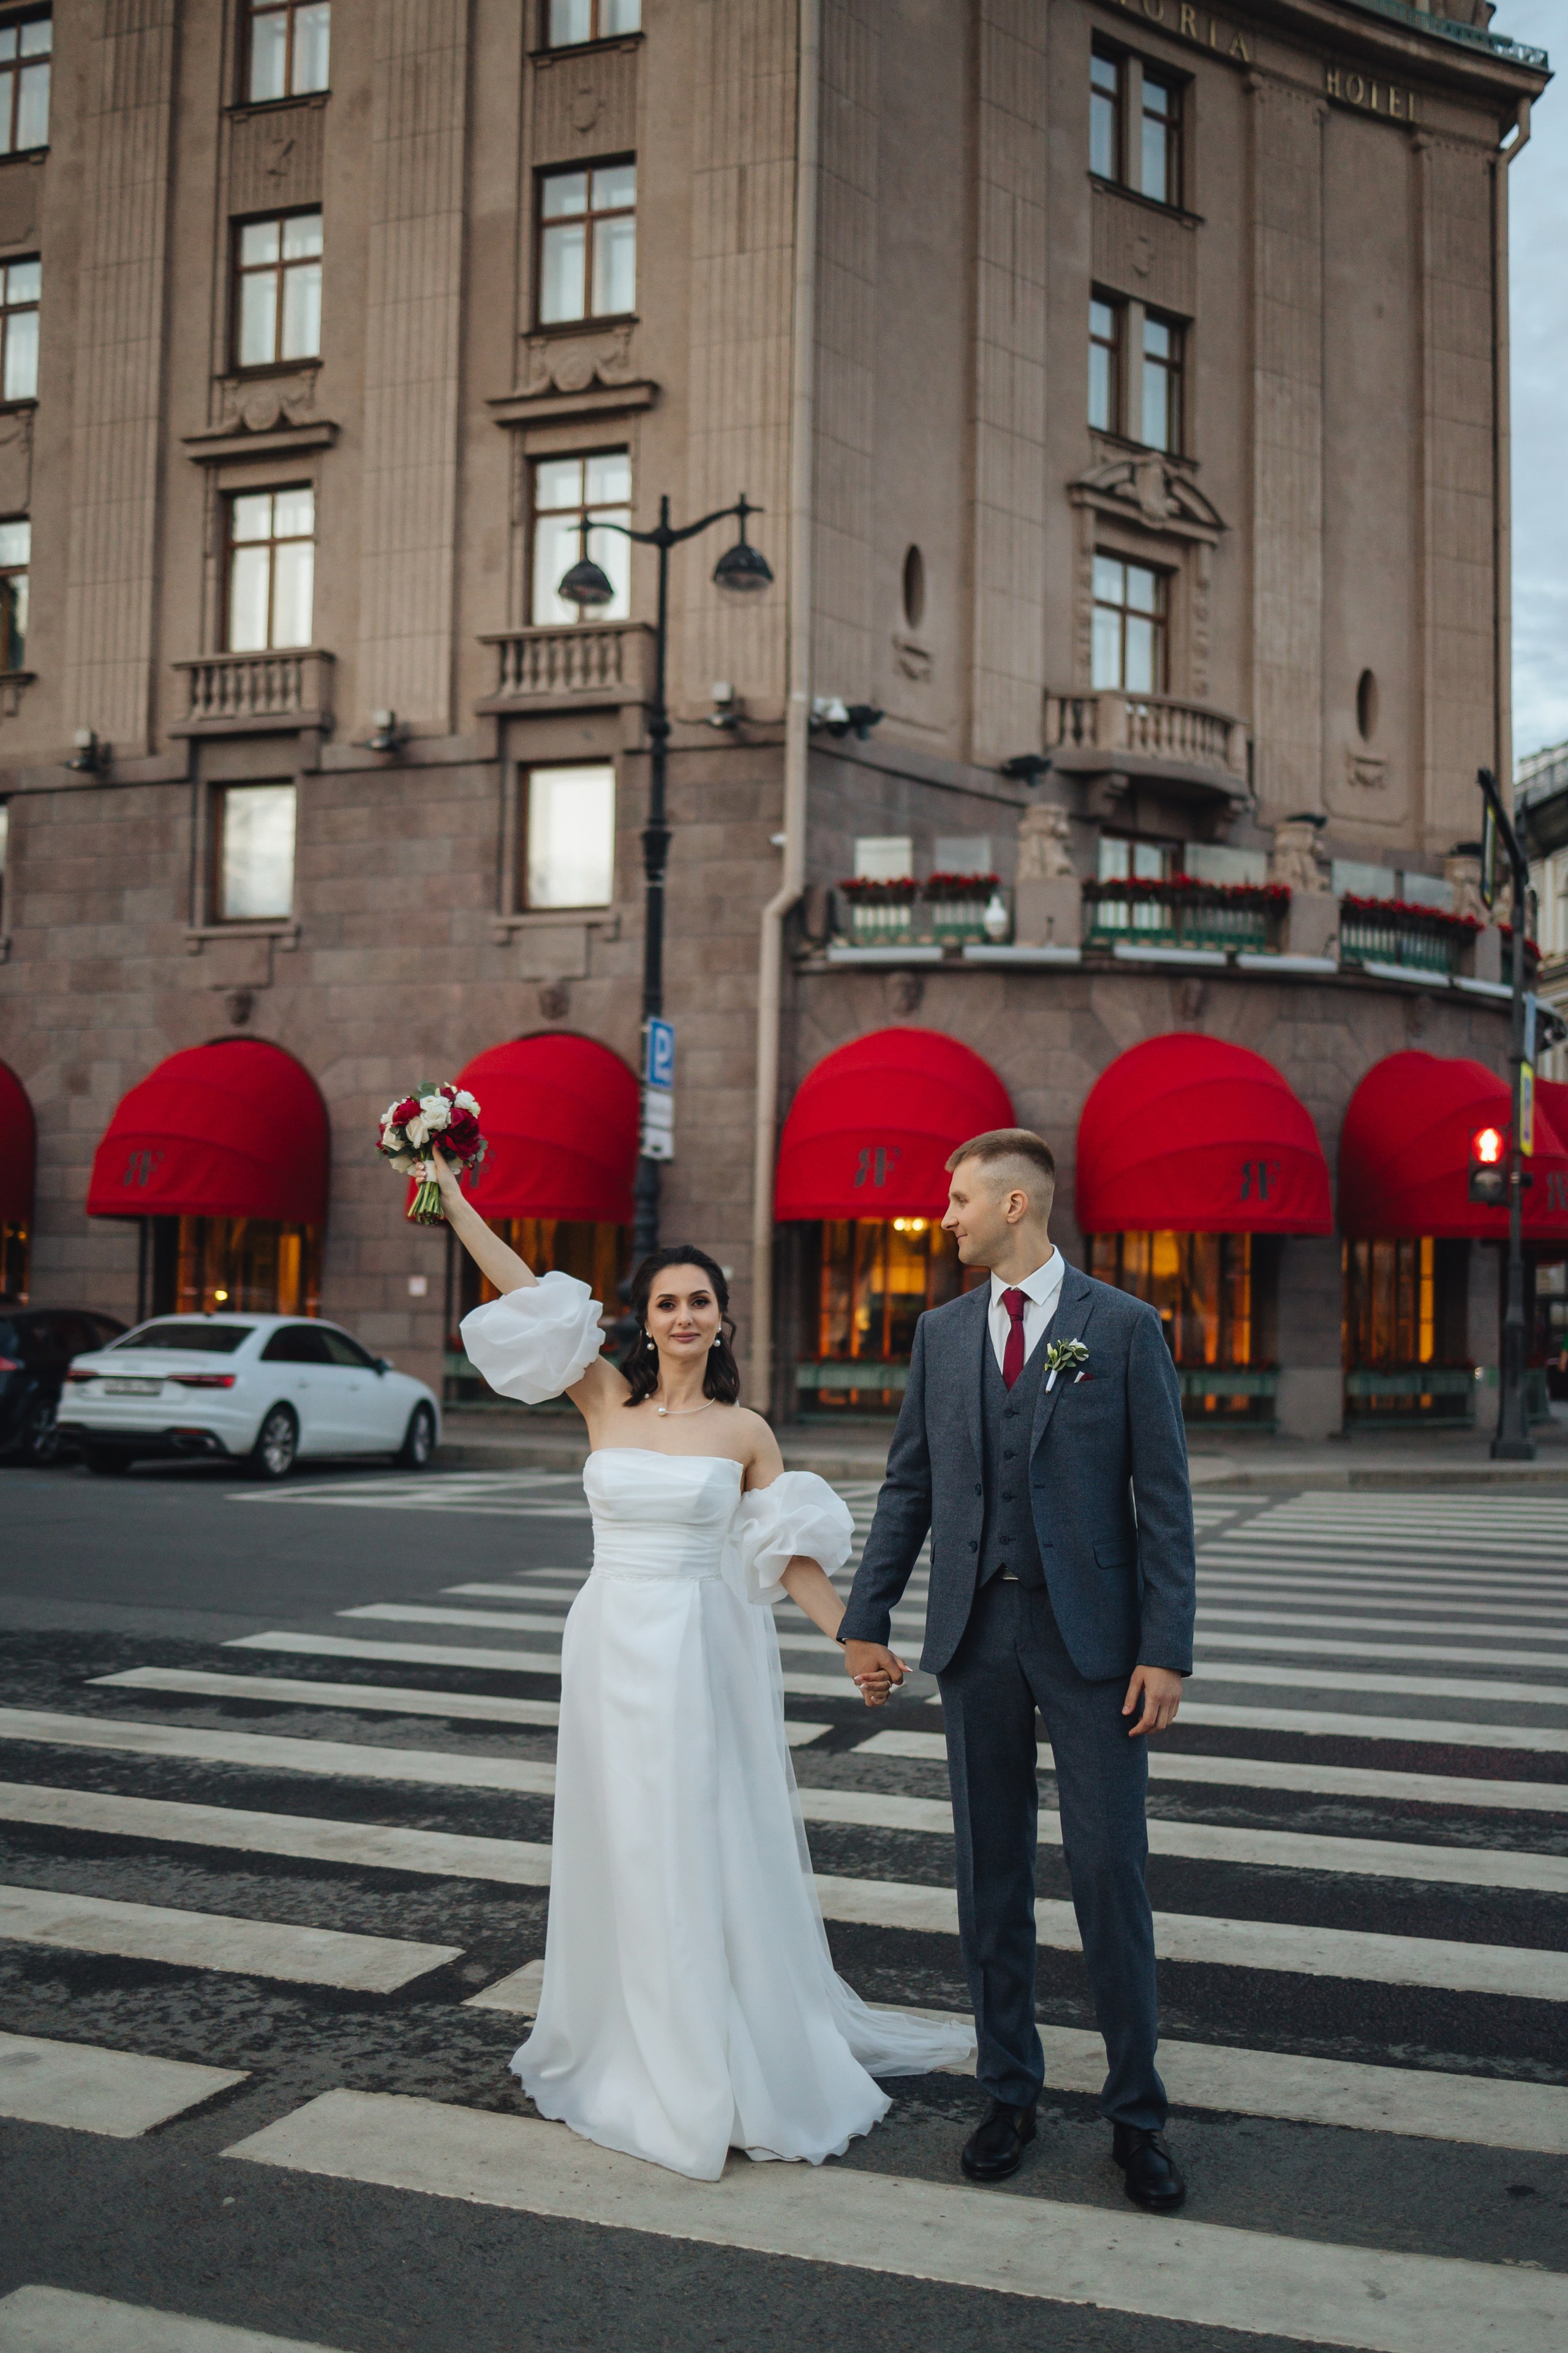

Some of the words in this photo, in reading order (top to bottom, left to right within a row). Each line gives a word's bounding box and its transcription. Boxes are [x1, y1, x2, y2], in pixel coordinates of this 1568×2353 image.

[1120, 0, 1250, 62] ORIA
[1327, 67, 1422, 122] HOTEL
[654, 1026, 671, 1079] P
